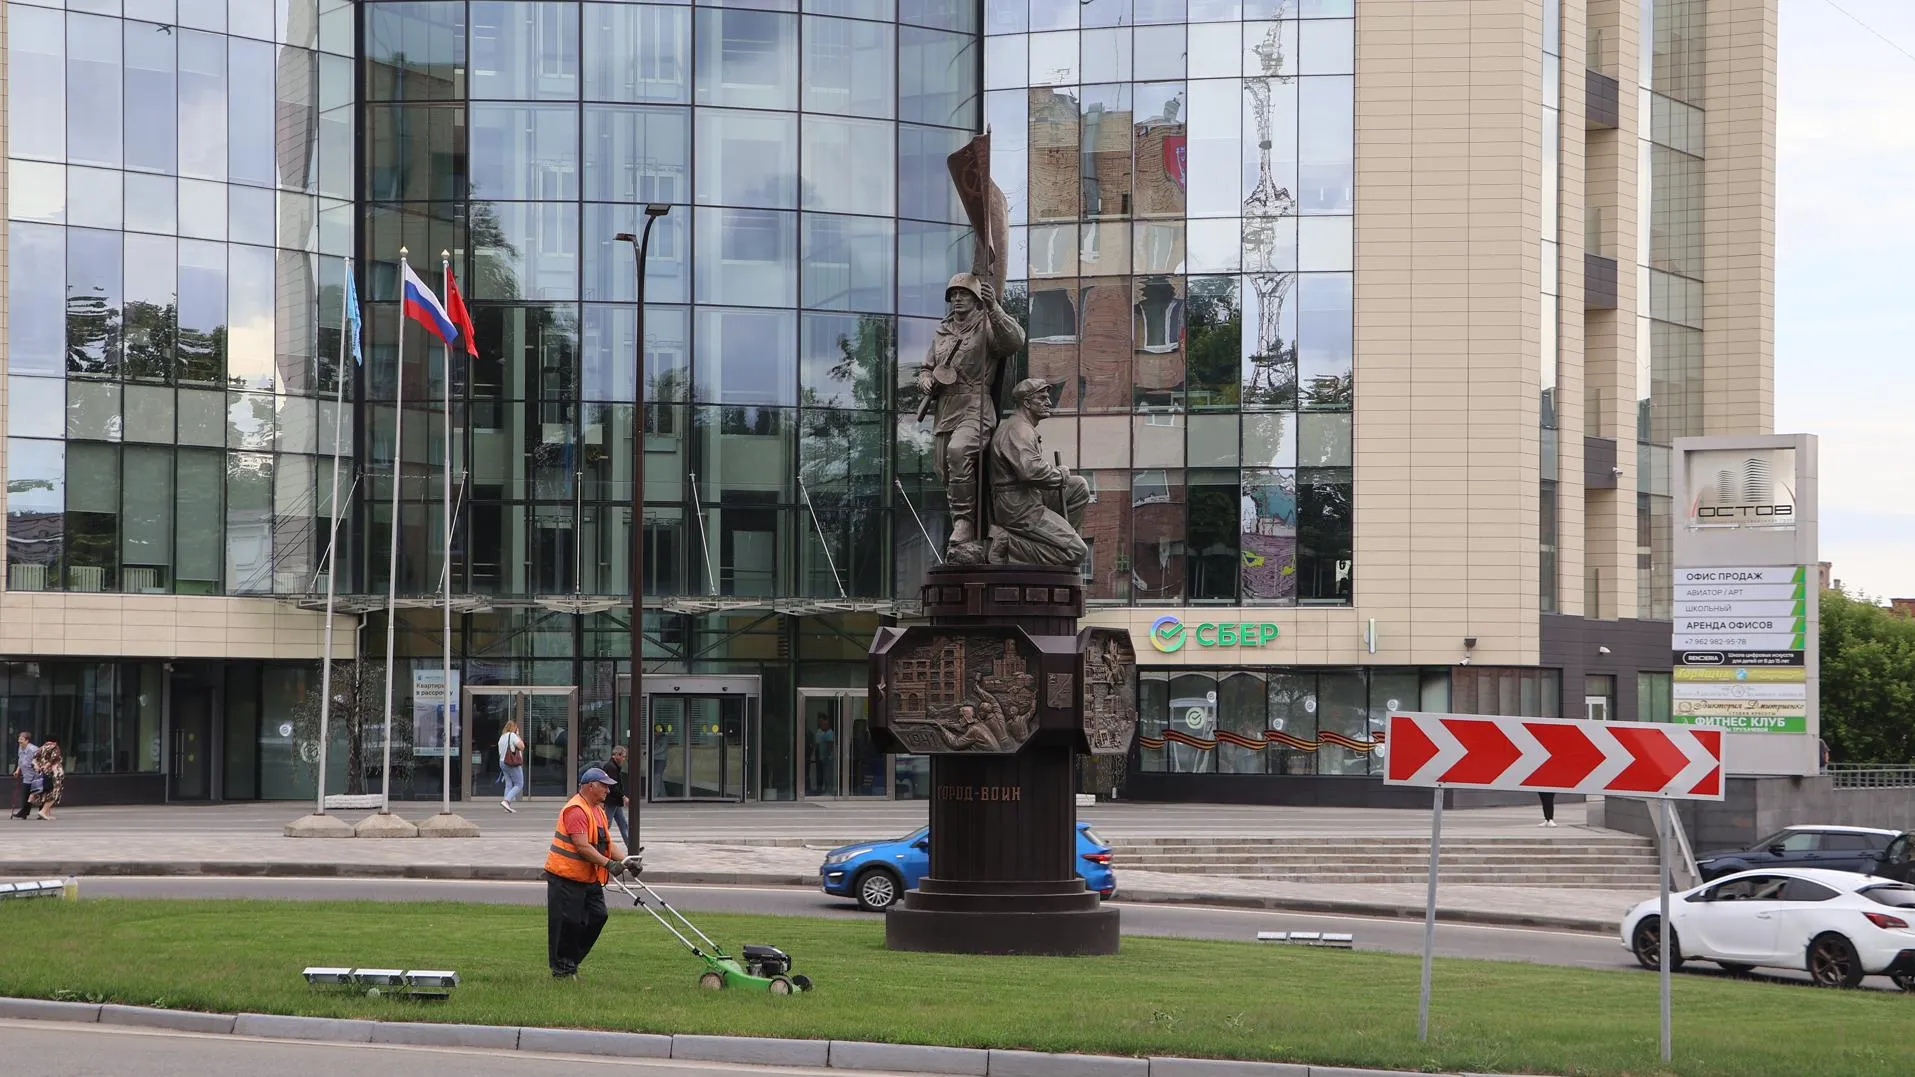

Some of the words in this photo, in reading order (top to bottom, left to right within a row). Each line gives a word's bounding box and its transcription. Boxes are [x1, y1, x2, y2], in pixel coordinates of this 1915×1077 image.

[1698, 504, 1793, 518] ОСТОВ
[1686, 573, 1717, 581] ОФИС
[1718, 572, 1763, 581] ПРОДАЖ
[1685, 603, 1732, 612] ШКОЛЬНЫЙ
[1686, 621, 1727, 630] АРЕНДА
[1728, 621, 1773, 629] ОФИСОВ
[1195, 622, 1280, 646] СБЕР
[1695, 717, 1748, 727] ФИТНЕС
[1750, 717, 1786, 727] КЛУБ
[937, 785, 1021, 801] ГОРОД-ВОИН
